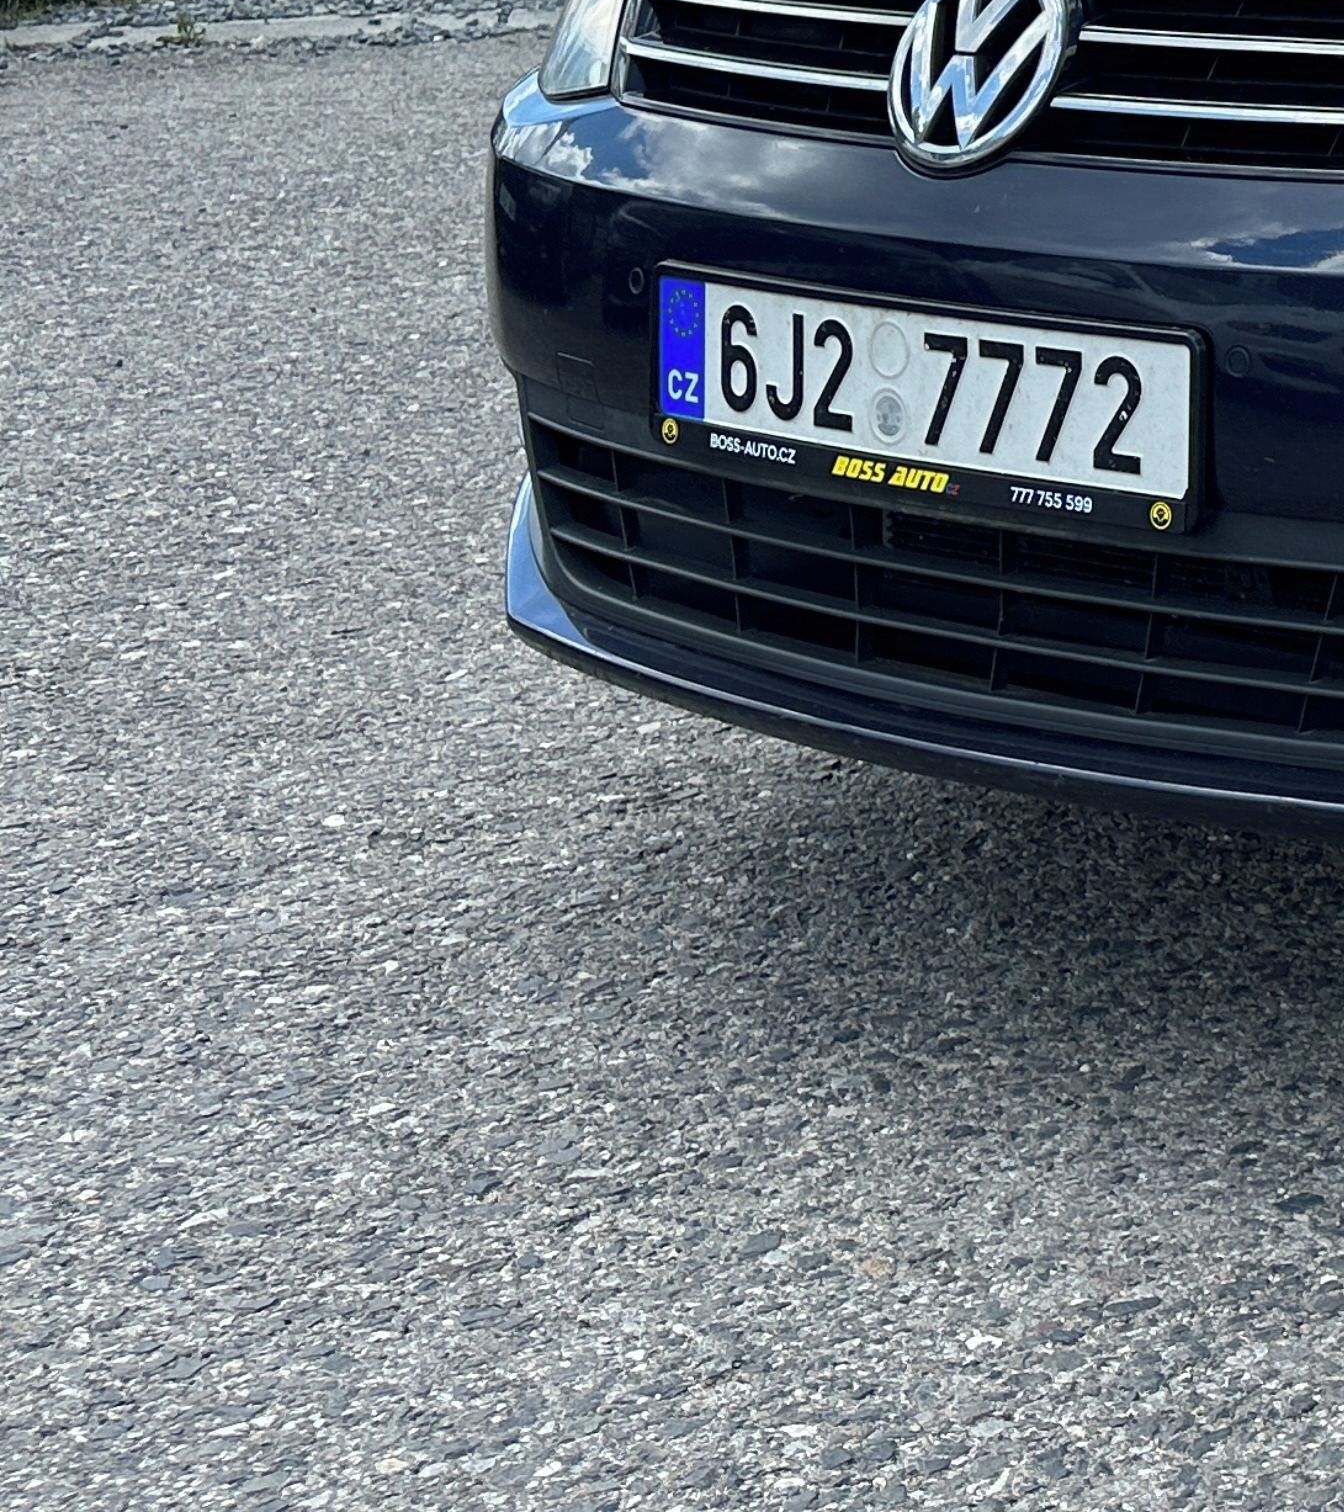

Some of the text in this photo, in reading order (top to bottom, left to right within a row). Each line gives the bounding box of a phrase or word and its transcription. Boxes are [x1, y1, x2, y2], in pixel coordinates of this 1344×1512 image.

[668, 369, 699, 403] CZ
[720, 304, 1142, 475] 6J2 7772
[710, 433, 796, 464] BOSS-AUTO.CZ
[832, 455, 886, 482] BOSS
[888, 466, 949, 494] AUTO
[1010, 486, 1034, 504] 777
[1037, 490, 1062, 509] 755
[1066, 494, 1092, 514] 599
